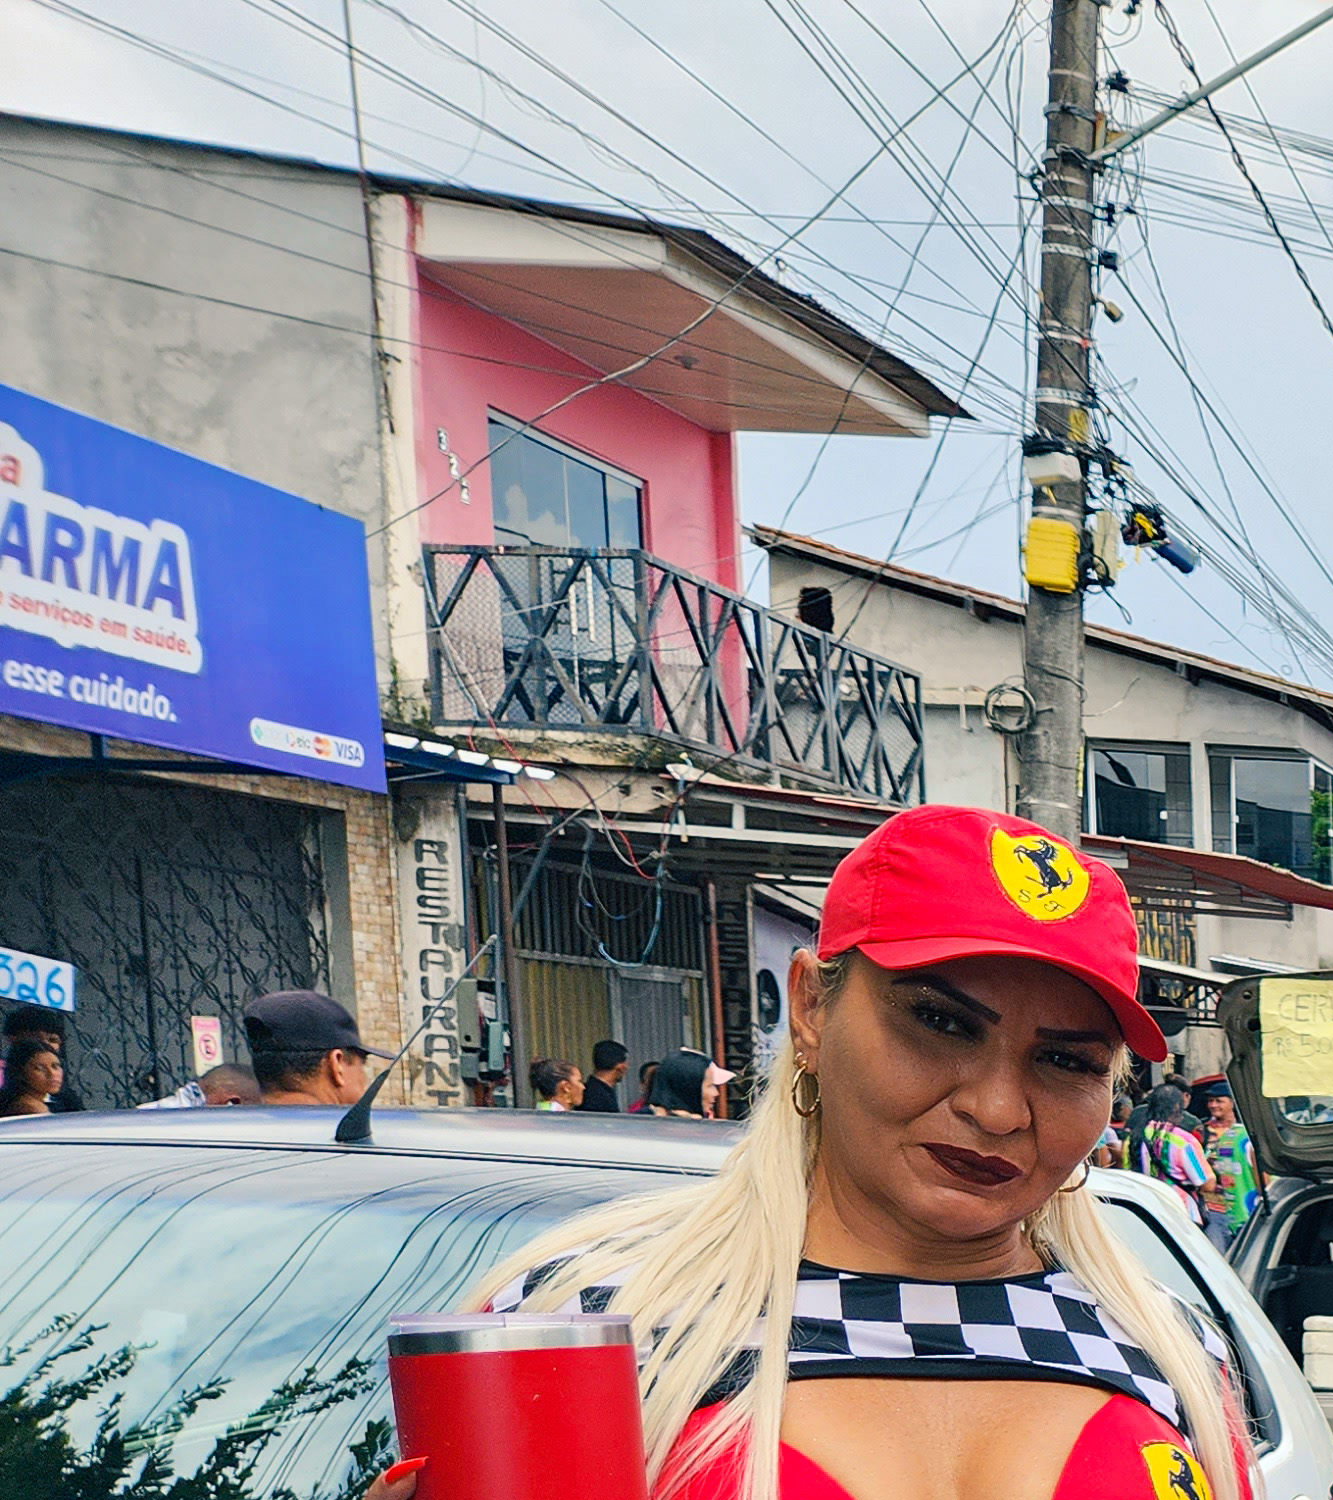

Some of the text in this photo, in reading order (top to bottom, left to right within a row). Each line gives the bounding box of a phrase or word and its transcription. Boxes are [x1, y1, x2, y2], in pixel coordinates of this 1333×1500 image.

[99, 616, 129, 638] em
[3, 659, 179, 723] esse cuidado.
[333, 741, 362, 762] VISA
[1017, 888, 1032, 904] S
